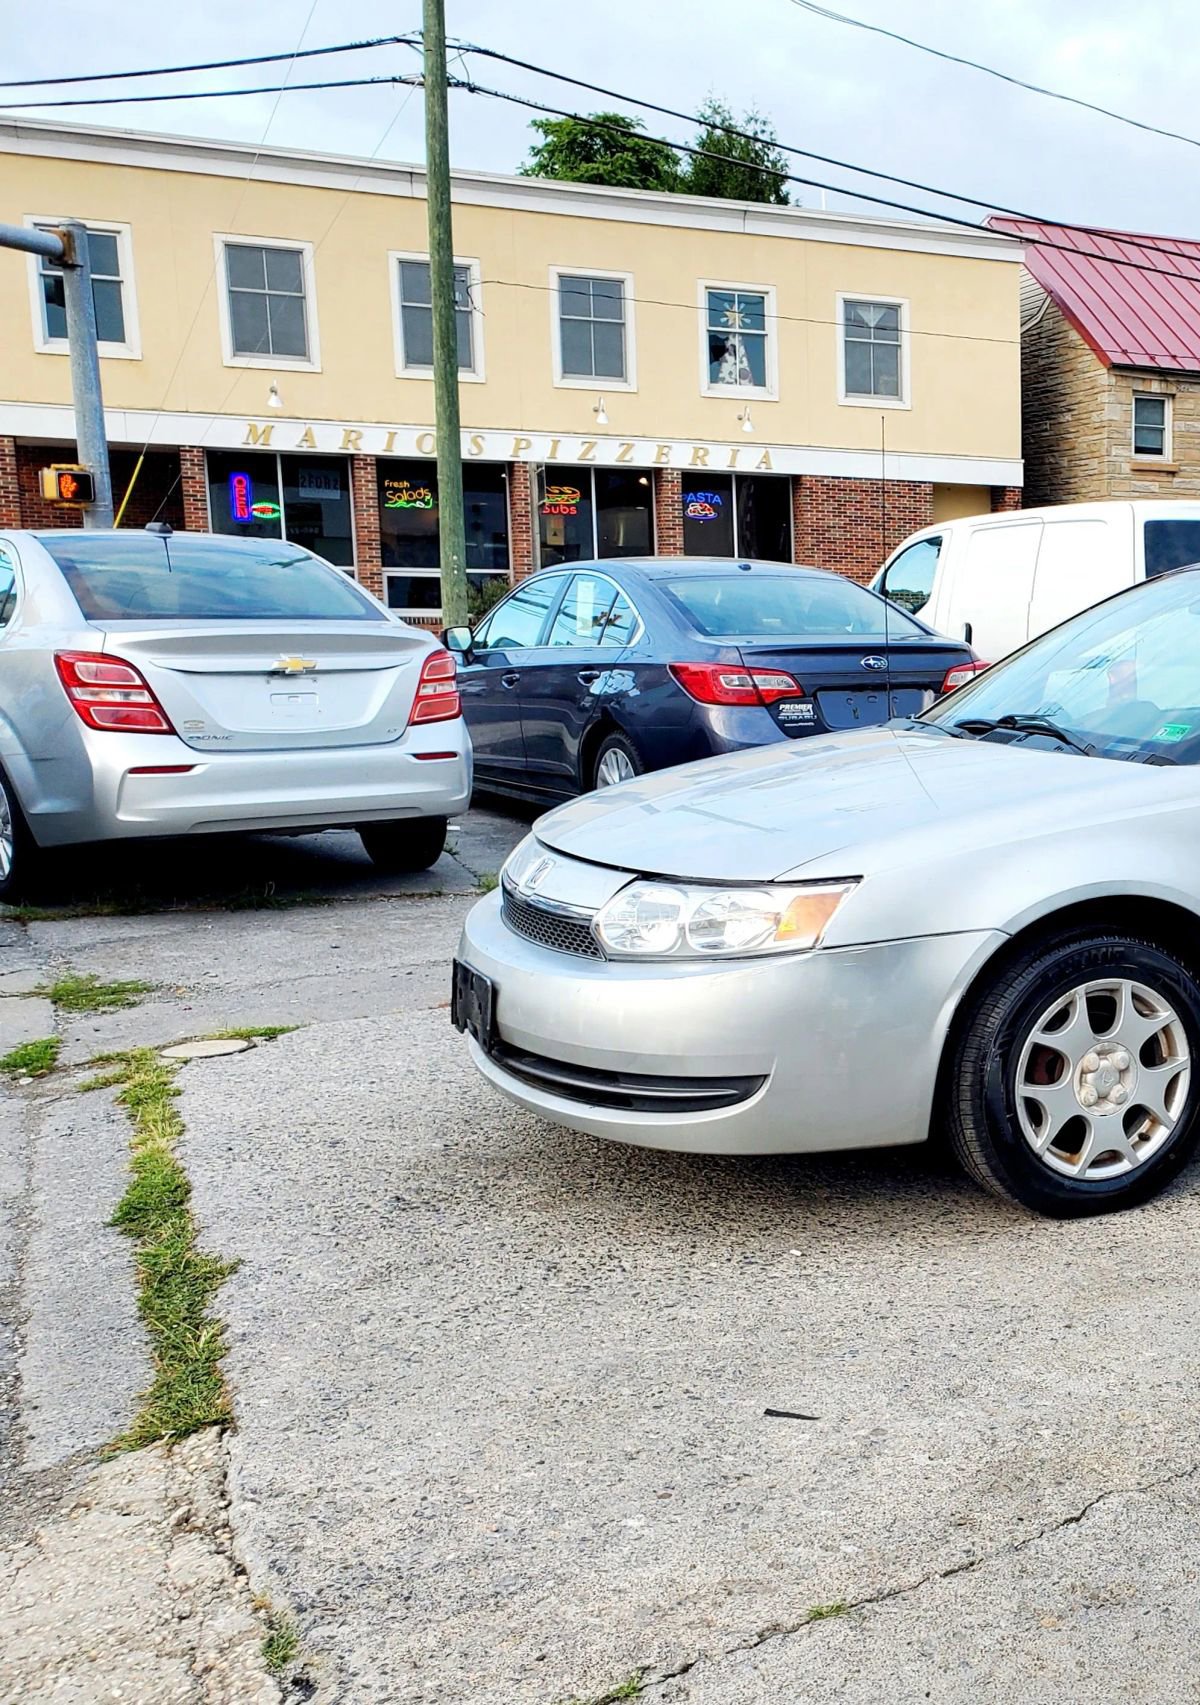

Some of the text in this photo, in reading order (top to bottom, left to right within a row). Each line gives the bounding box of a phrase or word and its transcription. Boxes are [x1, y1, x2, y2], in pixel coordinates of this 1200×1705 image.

[510, 436, 773, 470] PIZZERIA
[384, 479, 410, 488] Fresh
[233, 476, 248, 518] OPEN
[385, 487, 432, 503] Salads
[543, 503, 577, 515] Subs
